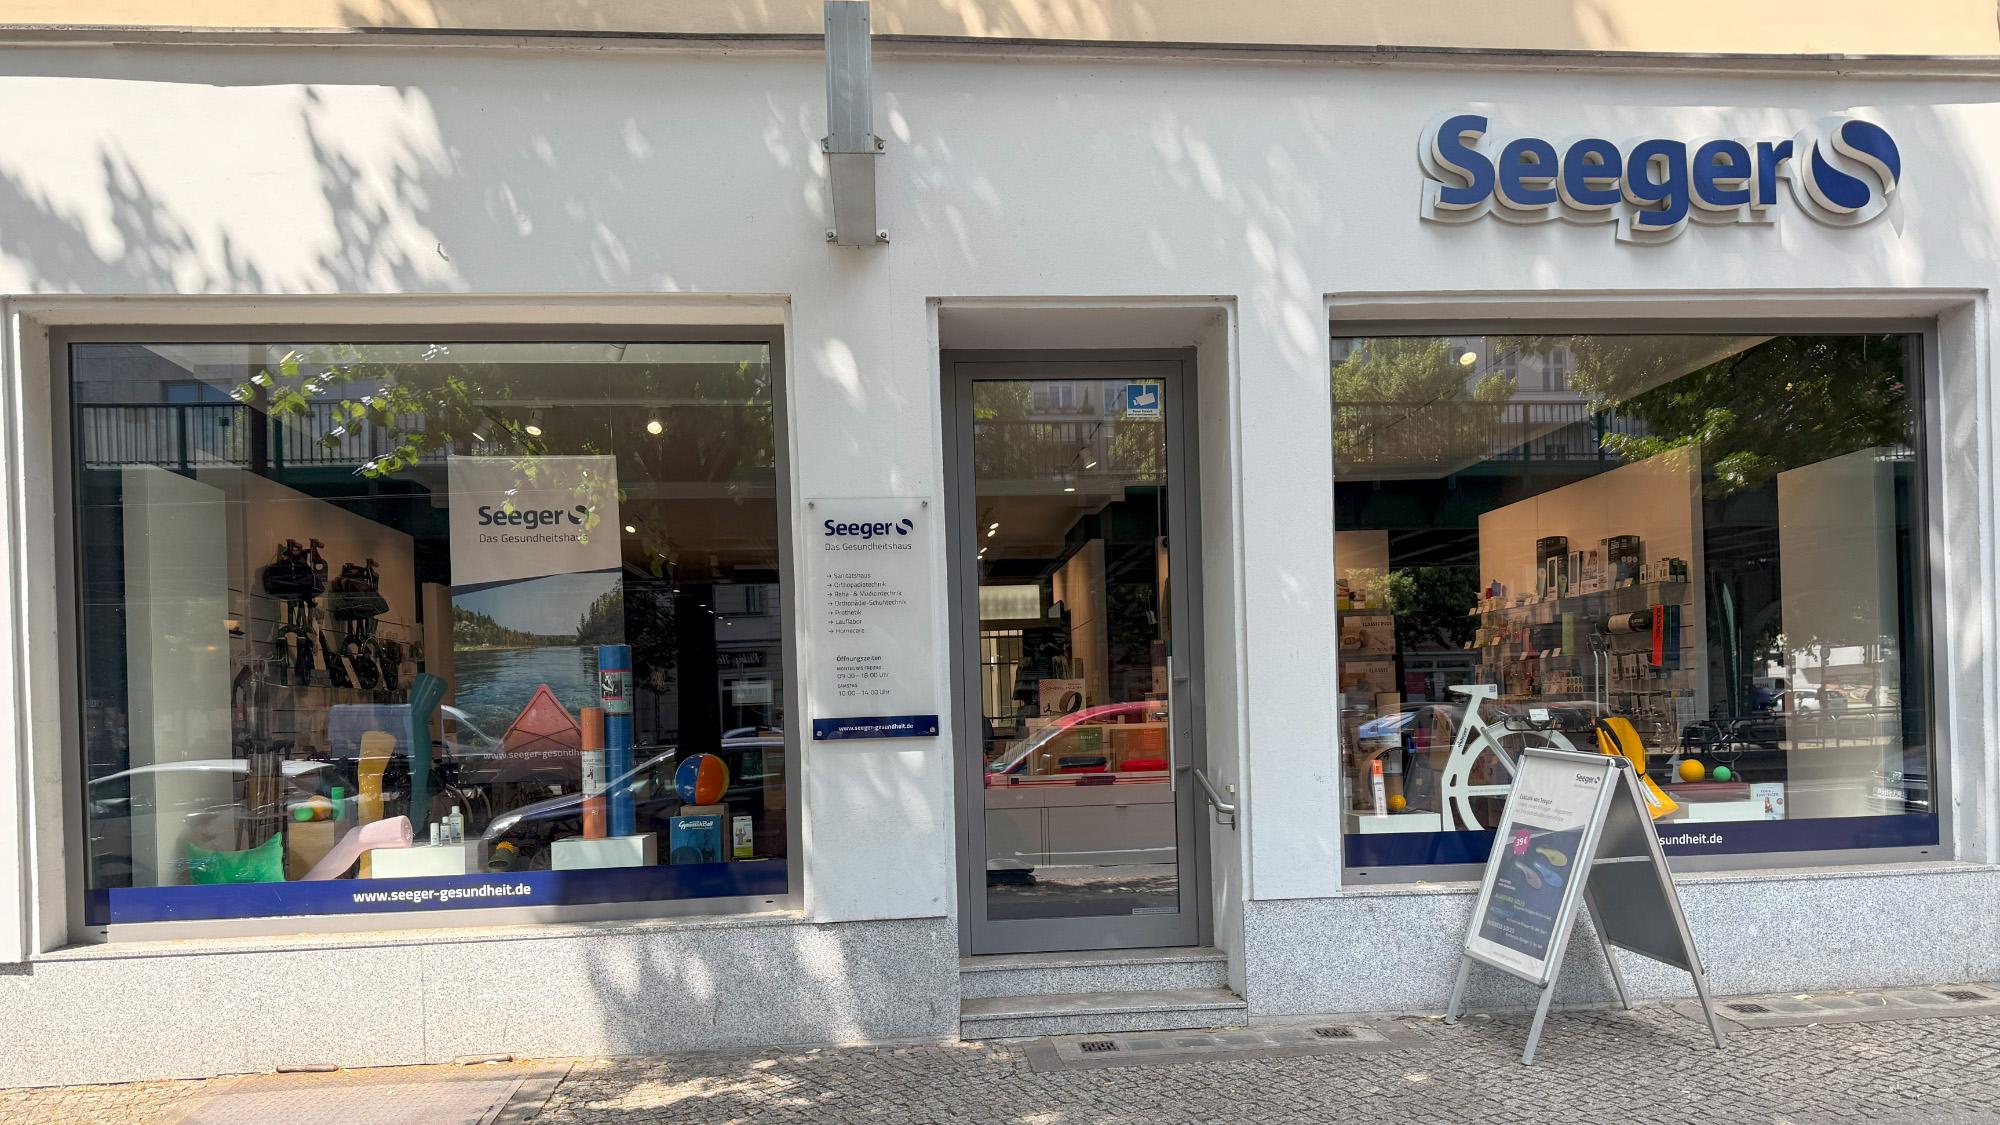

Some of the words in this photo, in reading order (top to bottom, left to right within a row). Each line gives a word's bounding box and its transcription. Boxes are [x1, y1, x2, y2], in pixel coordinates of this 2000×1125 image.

[1434, 114, 1794, 228] Seeger
[478, 505, 564, 530] Seeger
[824, 519, 893, 540] Seeger
[479, 533, 498, 543] Das
[501, 533, 588, 543] Gesundheitshaus
[825, 542, 841, 551] Das
[842, 541, 912, 551] Gesundheitshaus
[836, 654, 882, 662] Öffnungszeiten
[838, 723, 914, 731] www.seeger-gesundheit.de
[1575, 773, 1595, 785] Seeger
[1658, 832, 1723, 846] sundheit.de
[353, 882, 532, 903] www.seeger-gesundheit.de
